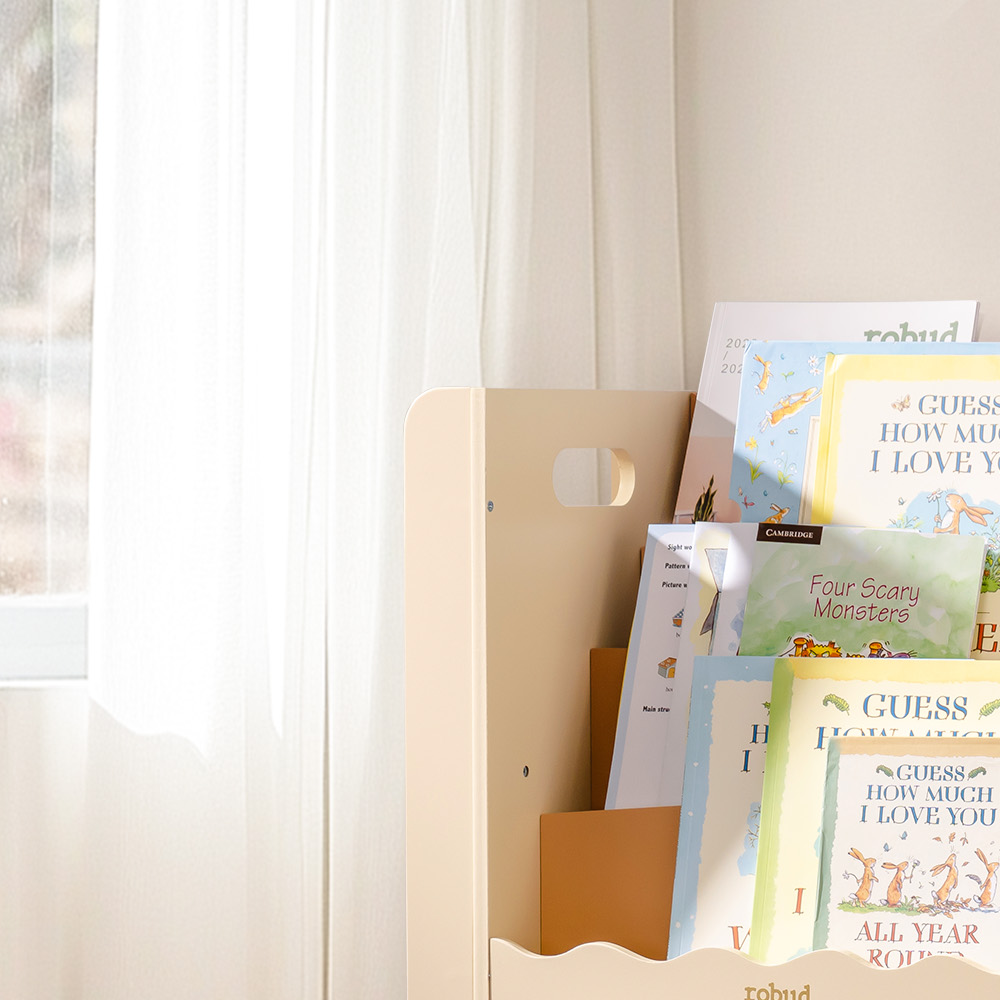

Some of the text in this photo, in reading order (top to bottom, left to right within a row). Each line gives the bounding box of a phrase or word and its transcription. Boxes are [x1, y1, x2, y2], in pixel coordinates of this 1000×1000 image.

[726, 338, 757, 349] 202
[878, 423, 948, 444] HOW
[869, 450, 881, 474] I
[891, 450, 972, 475] LOVE
[765, 528, 814, 539] CAMBRIDGE
[667, 543, 683, 552] Sight
[810, 574, 920, 607] Four Scary
[813, 597, 910, 623] Monsters
[642, 705, 656, 713] Main
[863, 693, 968, 721] GUESS
[740, 750, 752, 773] I
[896, 764, 965, 782] GUESS
[866, 784, 994, 803] HOW MUCH
[859, 804, 998, 826] I LOVE YOU
[792, 887, 806, 915] I
[854, 921, 980, 944] ALL YEAR
[867, 949, 964, 969] ROU
